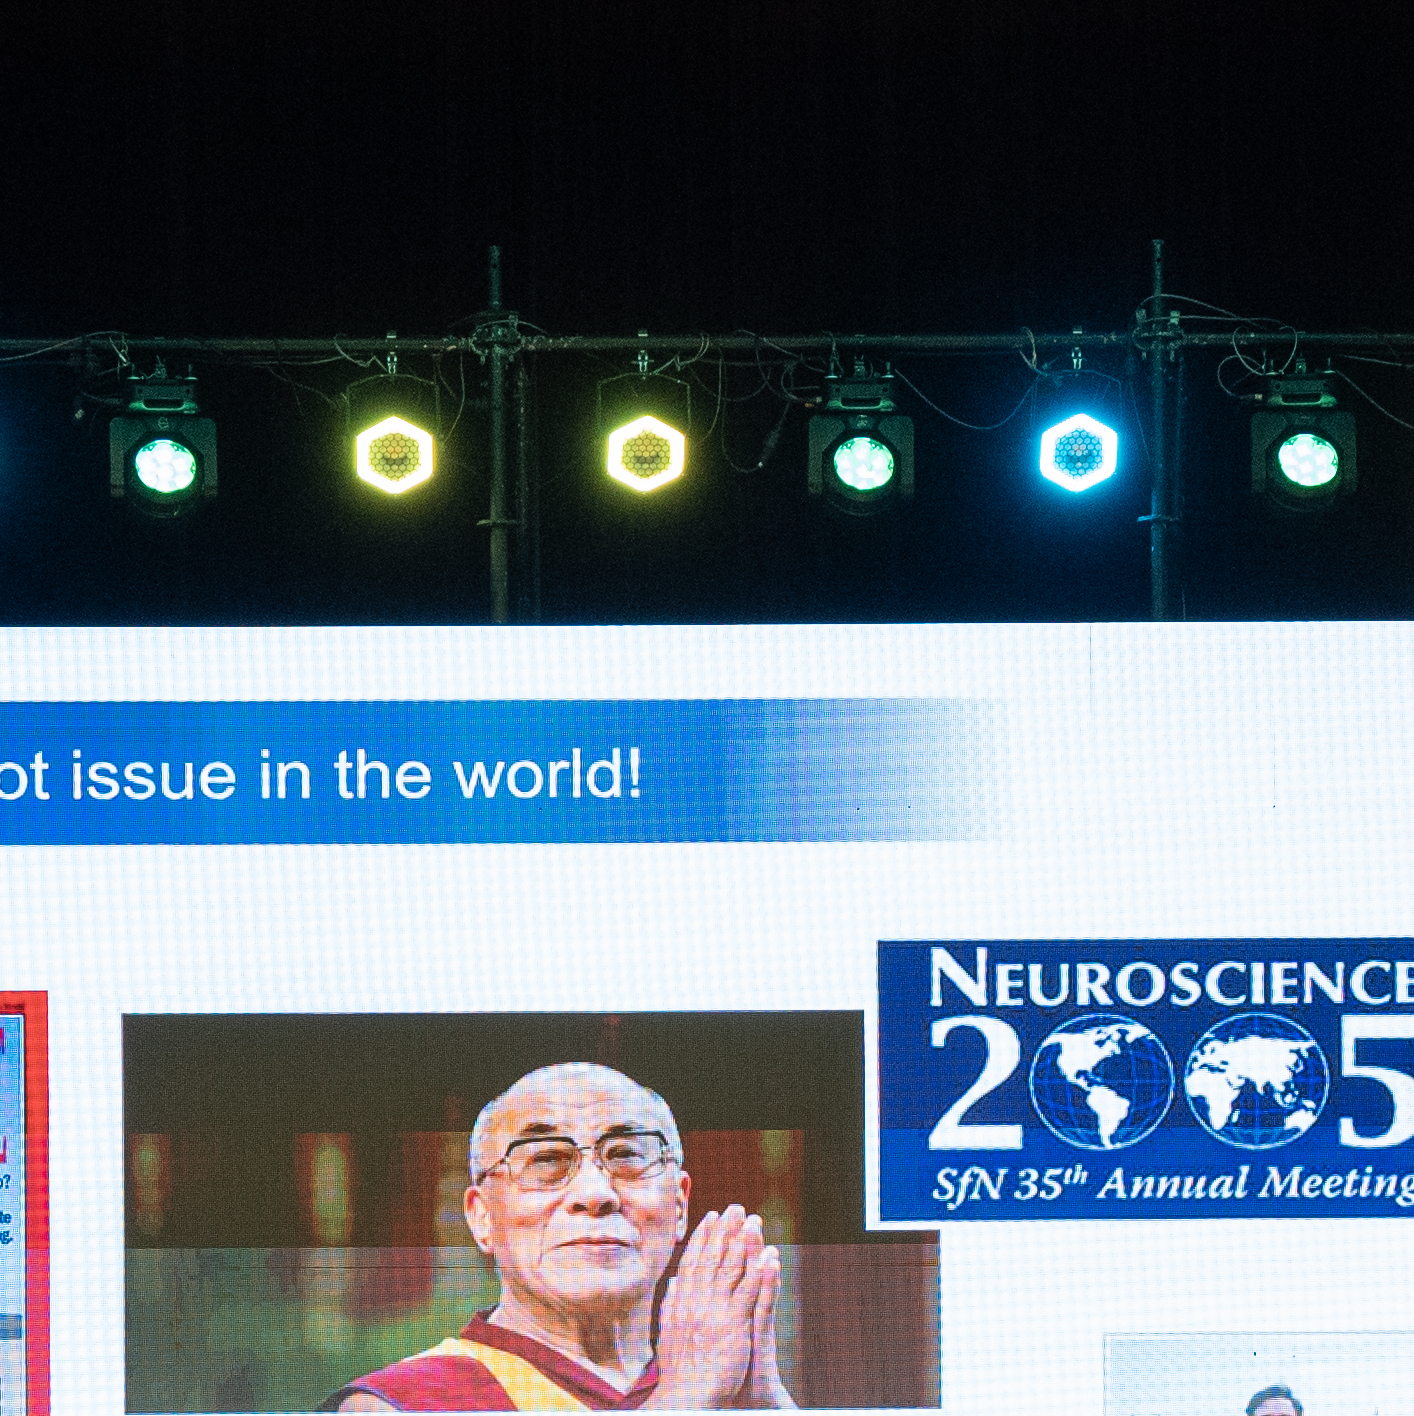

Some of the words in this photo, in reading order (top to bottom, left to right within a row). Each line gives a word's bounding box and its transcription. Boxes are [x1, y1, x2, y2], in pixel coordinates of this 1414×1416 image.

[73, 748, 236, 800] issue
[261, 748, 311, 799] in
[333, 747, 431, 799] the
[453, 746, 641, 799] world!
[931, 1165, 1007, 1211] SfN
[1097, 1164, 1251, 1200] Annual
